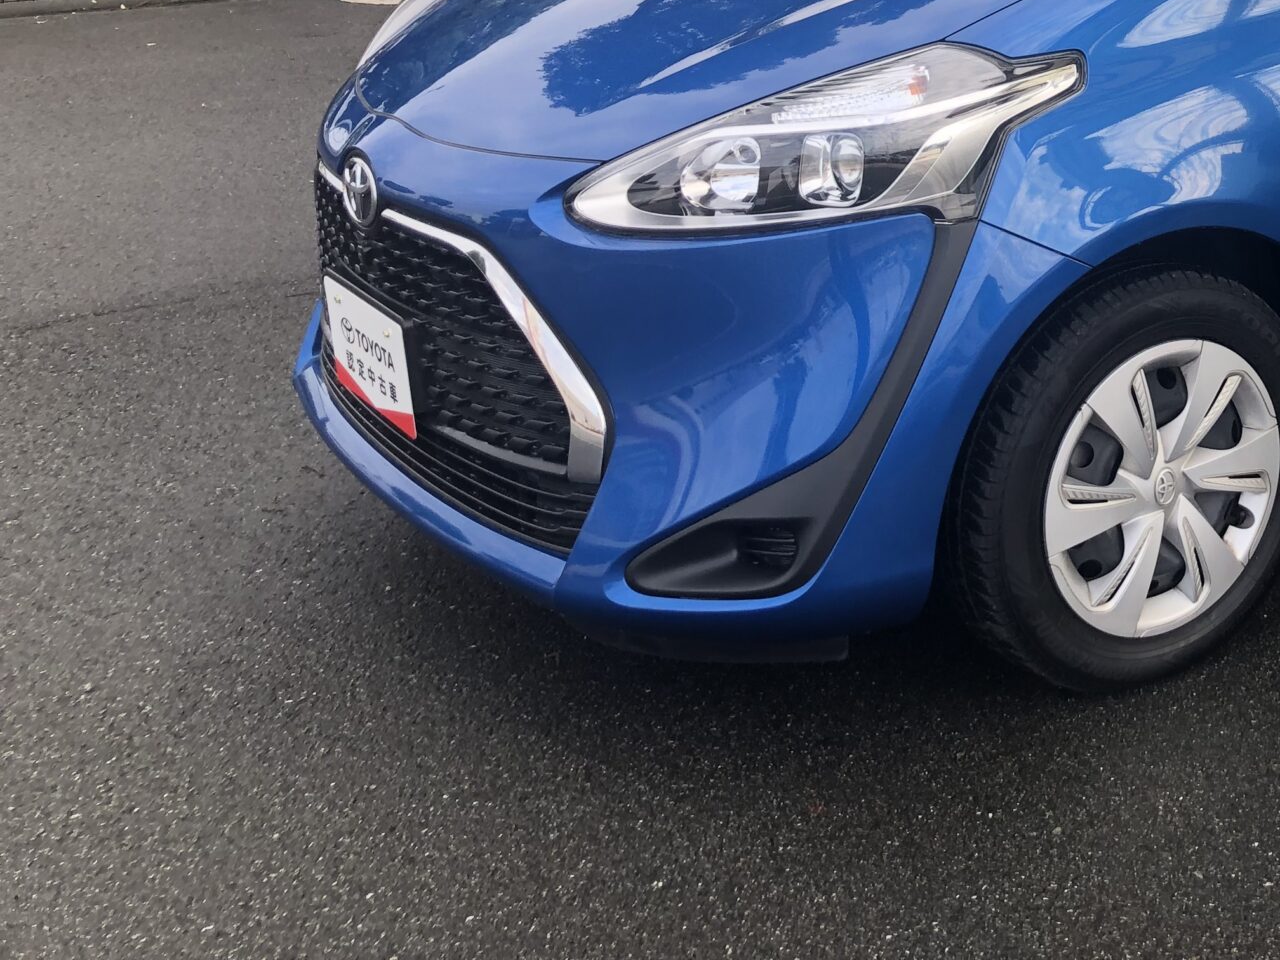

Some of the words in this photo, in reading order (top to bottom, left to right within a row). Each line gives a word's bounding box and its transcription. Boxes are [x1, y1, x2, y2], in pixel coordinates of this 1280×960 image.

[354, 328, 396, 374] TOYOTA
[345, 349, 399, 404] 認定中古車
